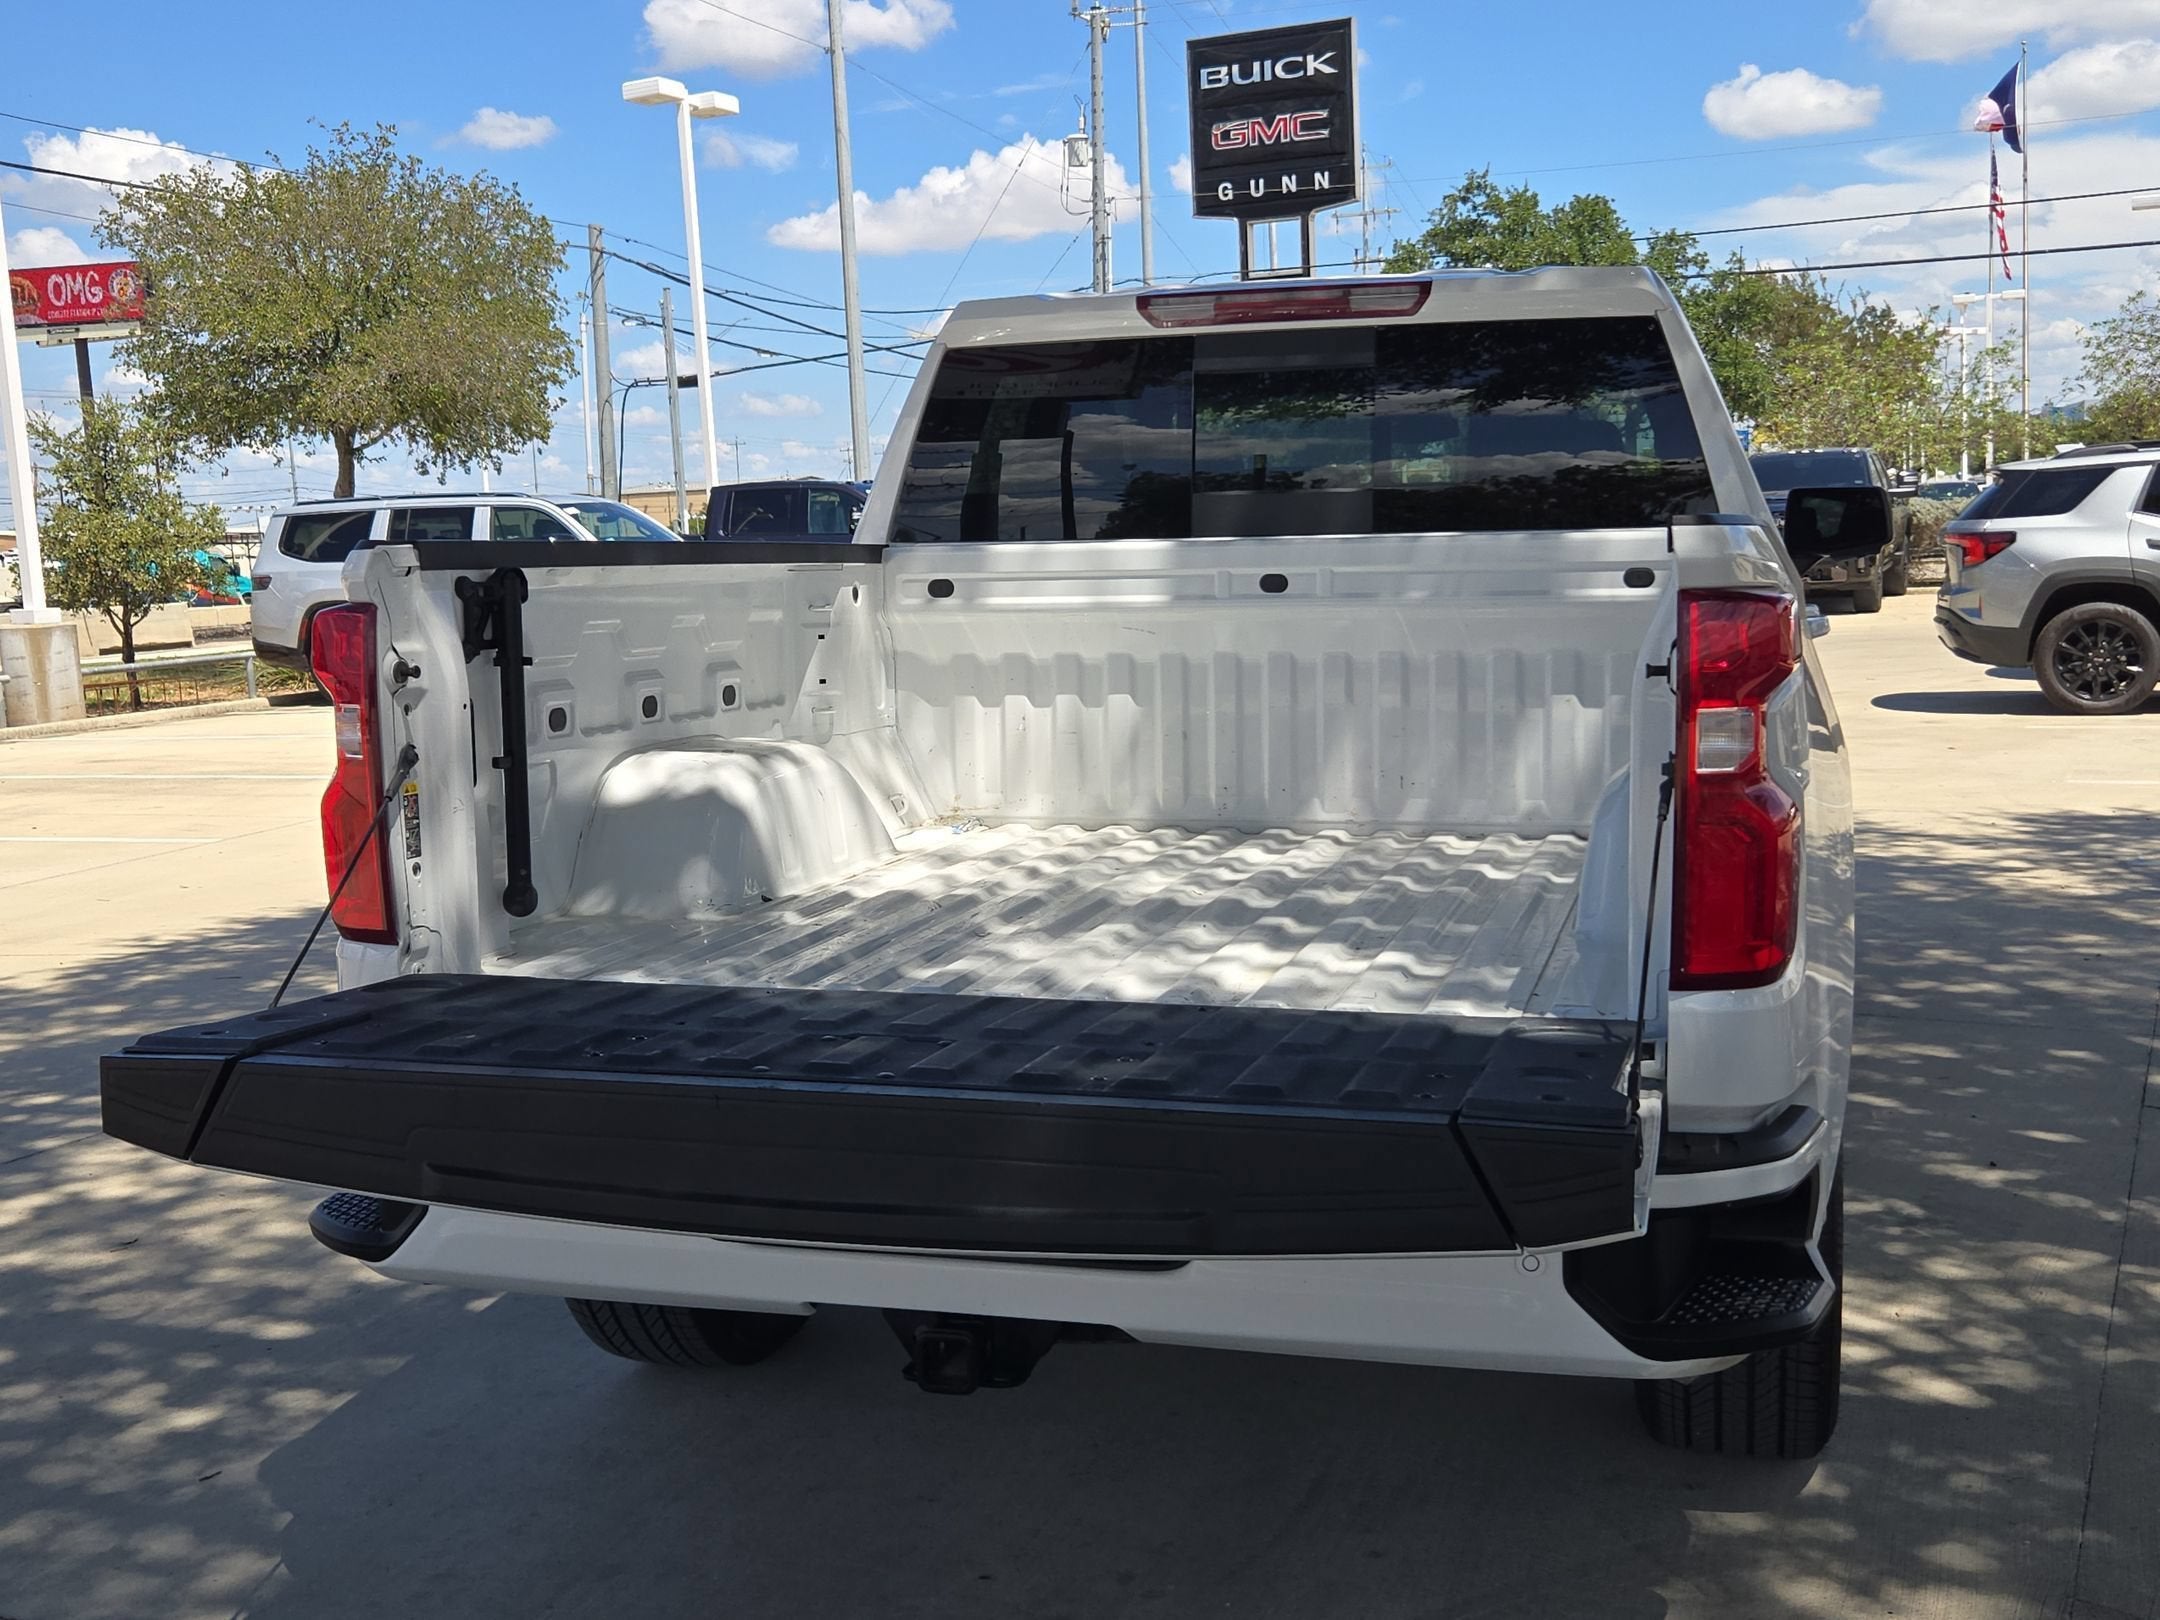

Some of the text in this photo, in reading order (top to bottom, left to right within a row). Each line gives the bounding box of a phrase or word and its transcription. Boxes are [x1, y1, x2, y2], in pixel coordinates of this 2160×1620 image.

[1200, 51, 1339, 90] BUICK
[1211, 109, 1331, 151] GMC
[1217, 170, 1331, 201] GUNN
[47, 270, 104, 307] OMG
